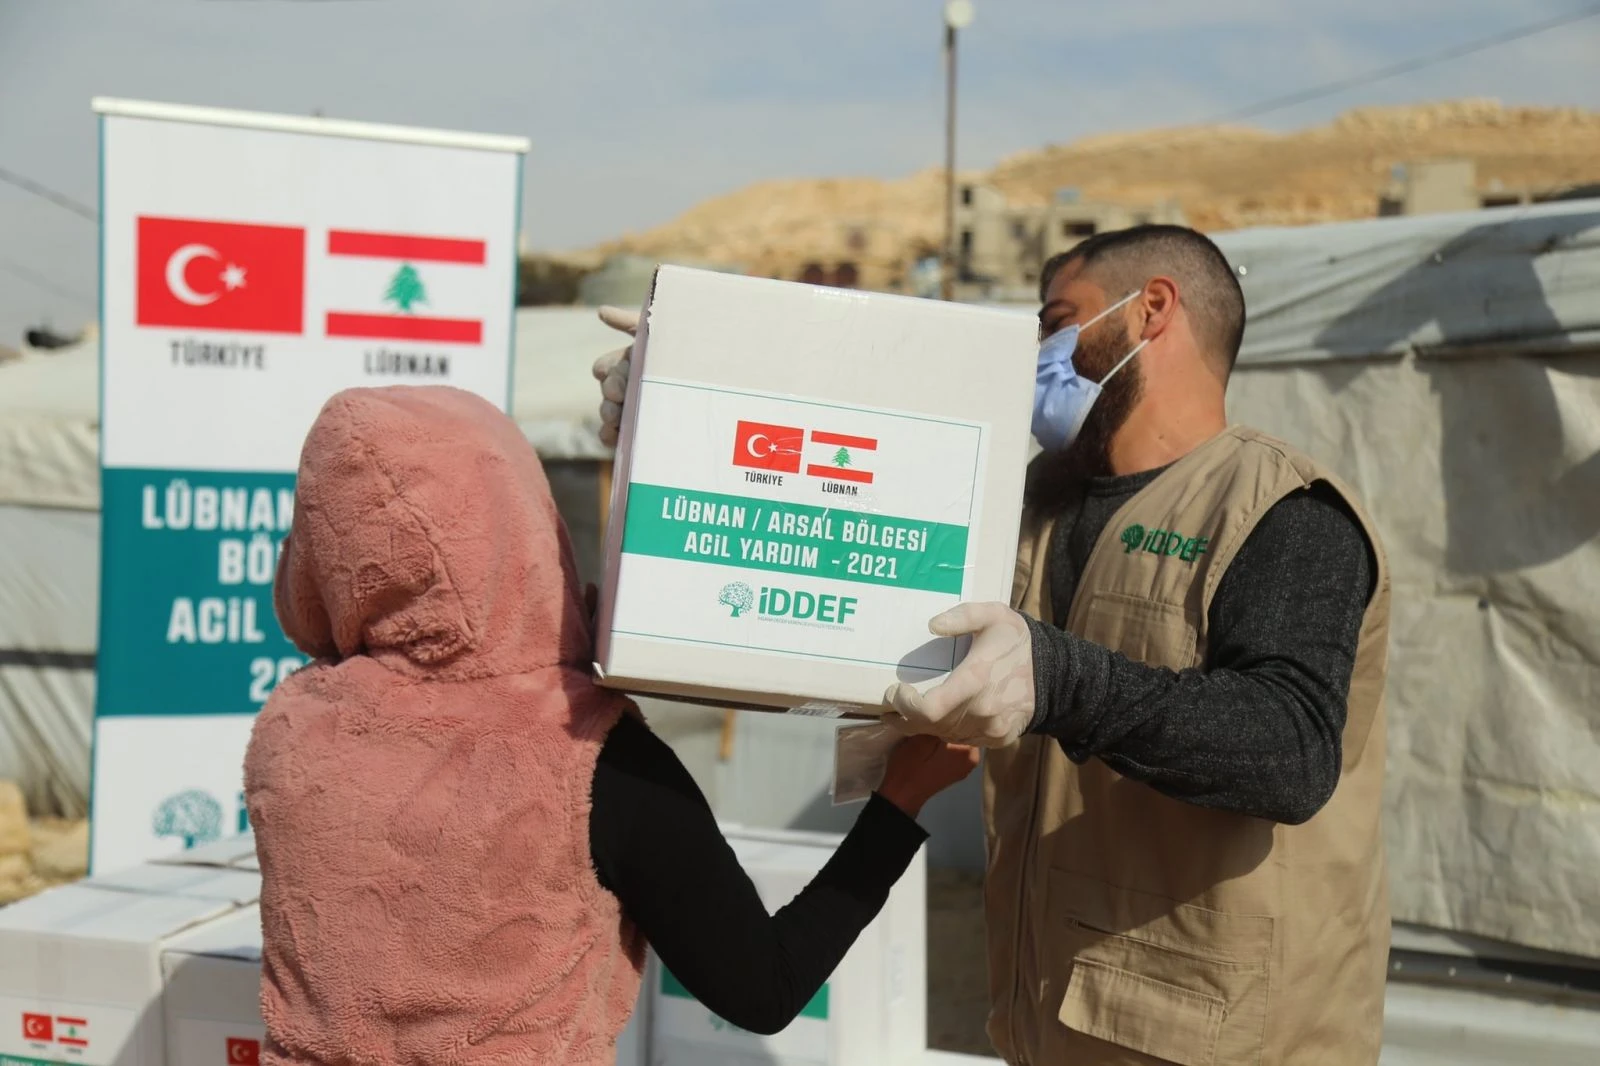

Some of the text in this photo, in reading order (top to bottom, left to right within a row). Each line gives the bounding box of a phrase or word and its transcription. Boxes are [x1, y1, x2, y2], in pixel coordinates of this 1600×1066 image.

[364, 349, 450, 376] LÜBNAN
[745, 471, 783, 486] TÜRKİYE
[822, 481, 858, 496] LÜBNAN
[662, 495, 927, 552] LÜBNAN / ARSAL BÖLGESİ
[740, 537, 819, 569] YARDIM
[847, 551, 897, 579] 2021
